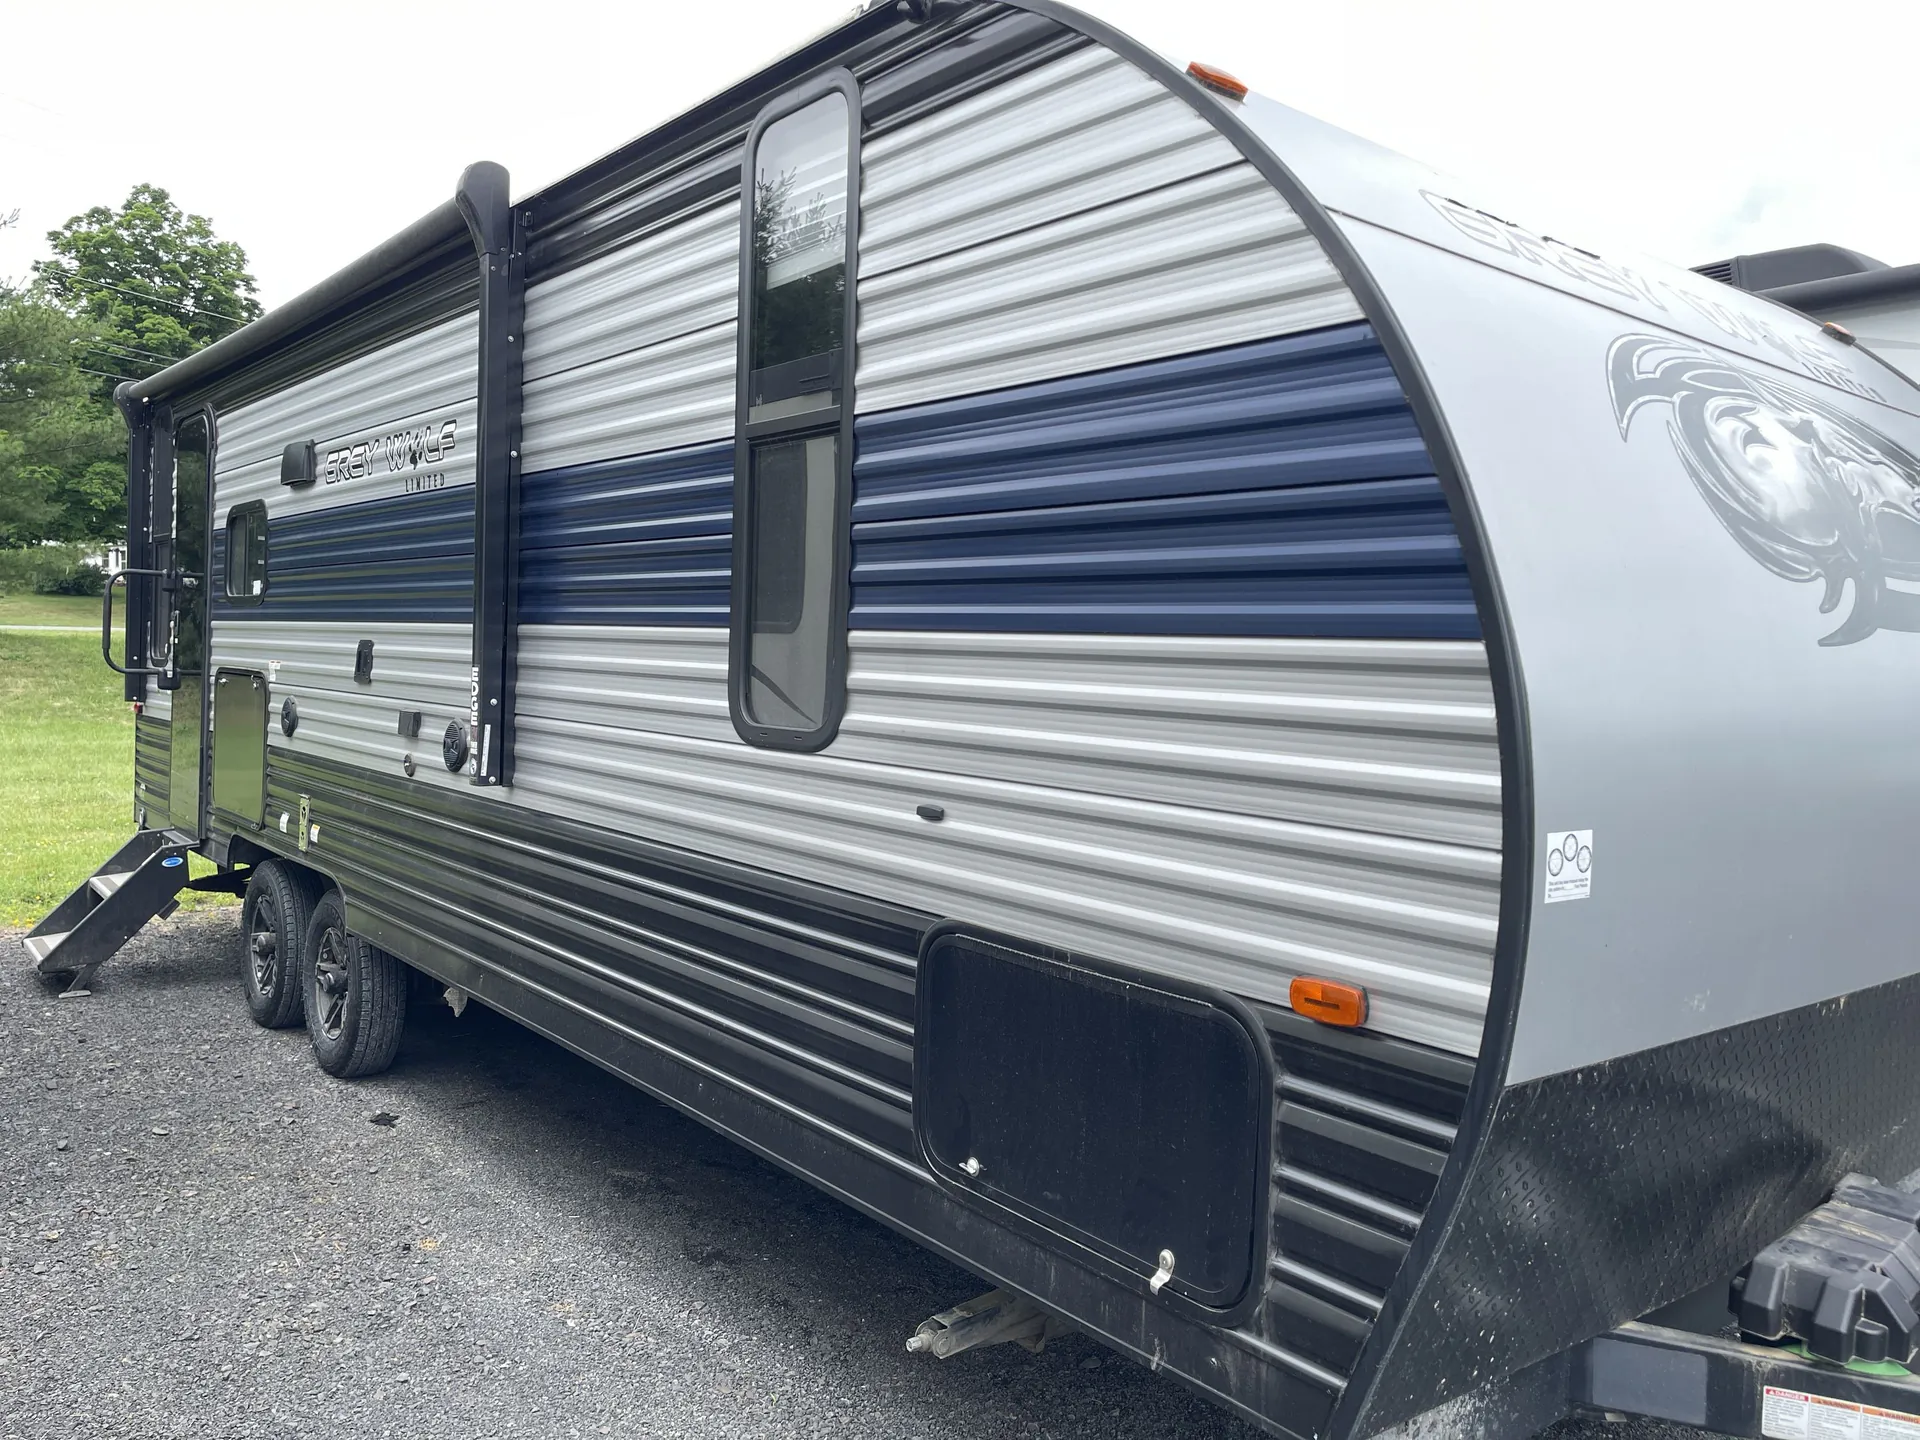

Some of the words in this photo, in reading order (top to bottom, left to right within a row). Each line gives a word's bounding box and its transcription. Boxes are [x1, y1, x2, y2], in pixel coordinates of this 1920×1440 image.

[1418, 188, 1669, 313] GREY
[324, 438, 380, 485] GREY
[405, 472, 445, 493] LIMITED
[1775, 1390, 1806, 1401] DANGER
[1884, 1413, 1920, 1425] WARNING
